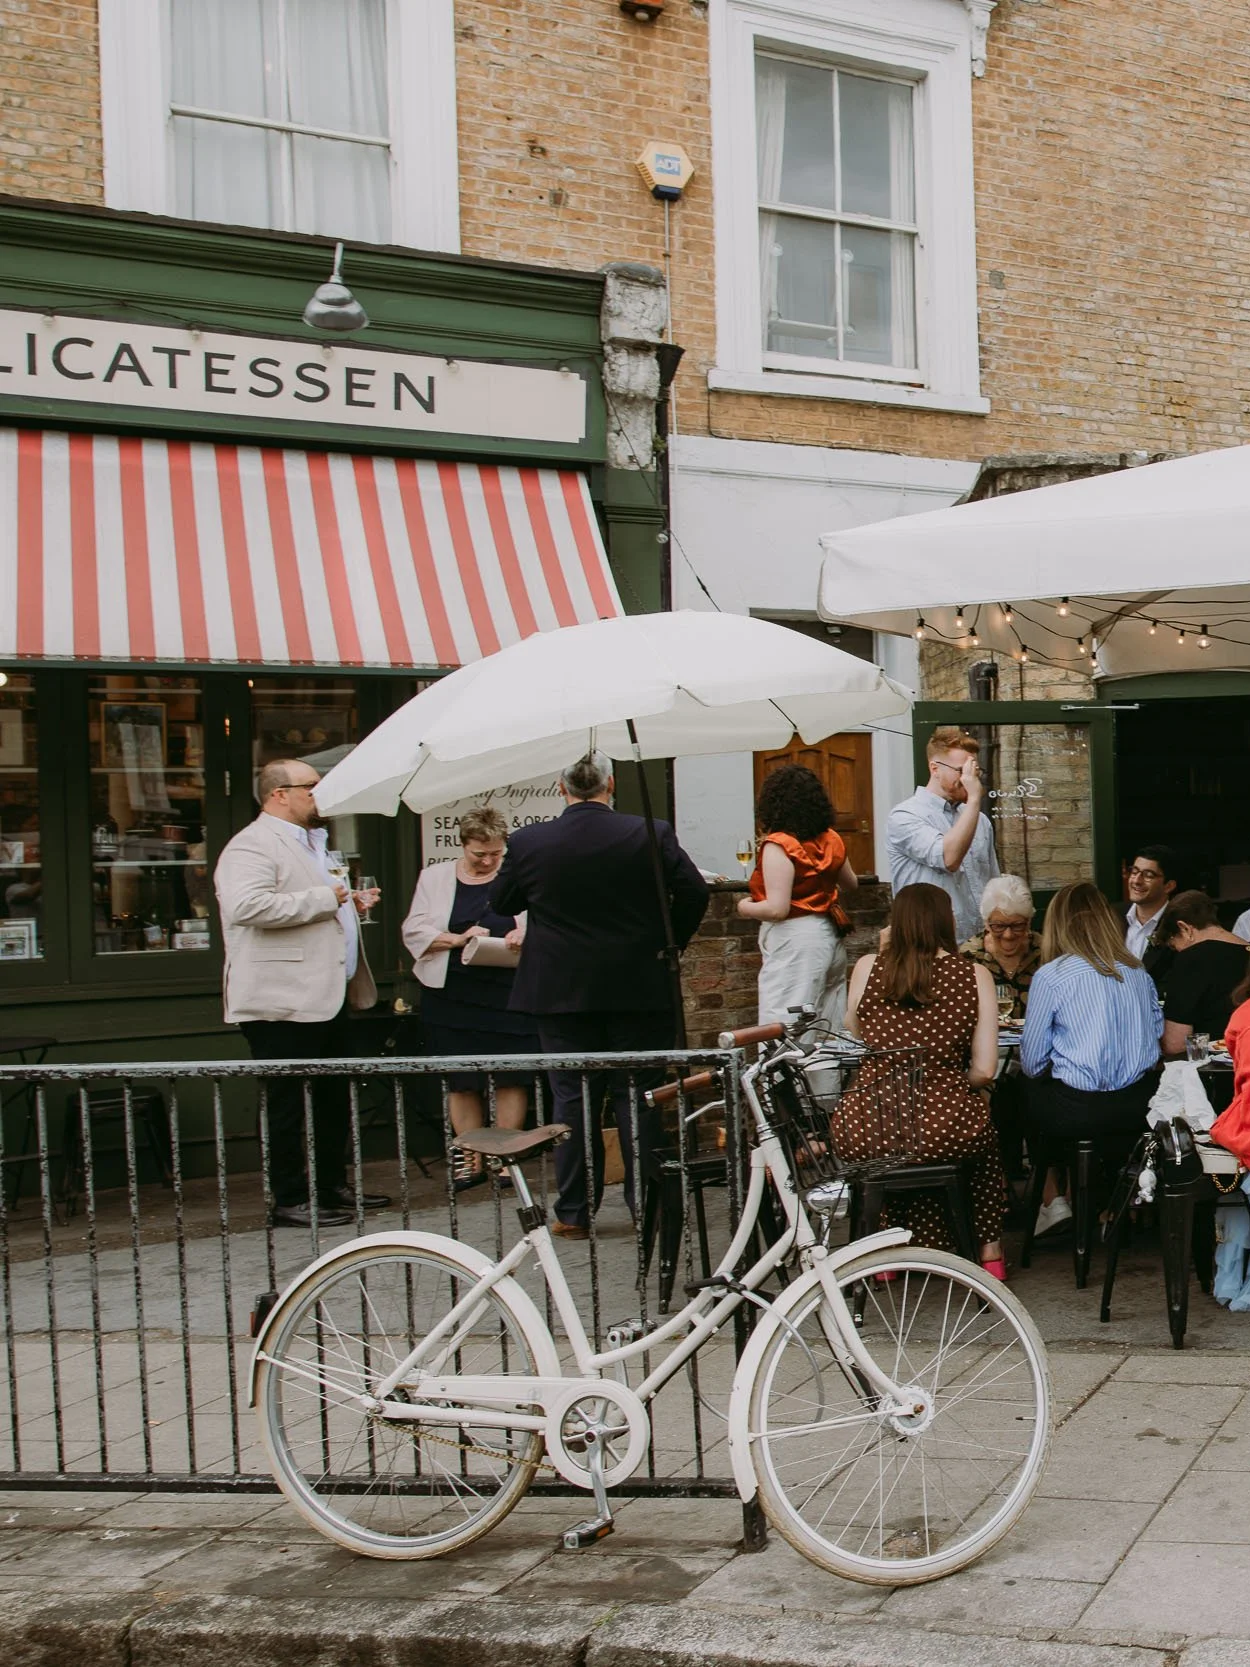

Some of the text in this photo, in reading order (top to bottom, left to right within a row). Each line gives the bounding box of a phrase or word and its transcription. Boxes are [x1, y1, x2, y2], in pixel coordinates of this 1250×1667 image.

[0, 332, 436, 414] ICATESSEN
[494, 781, 562, 808] Ingredi
[434, 816, 461, 829] SEA
[435, 835, 463, 847] FRU
